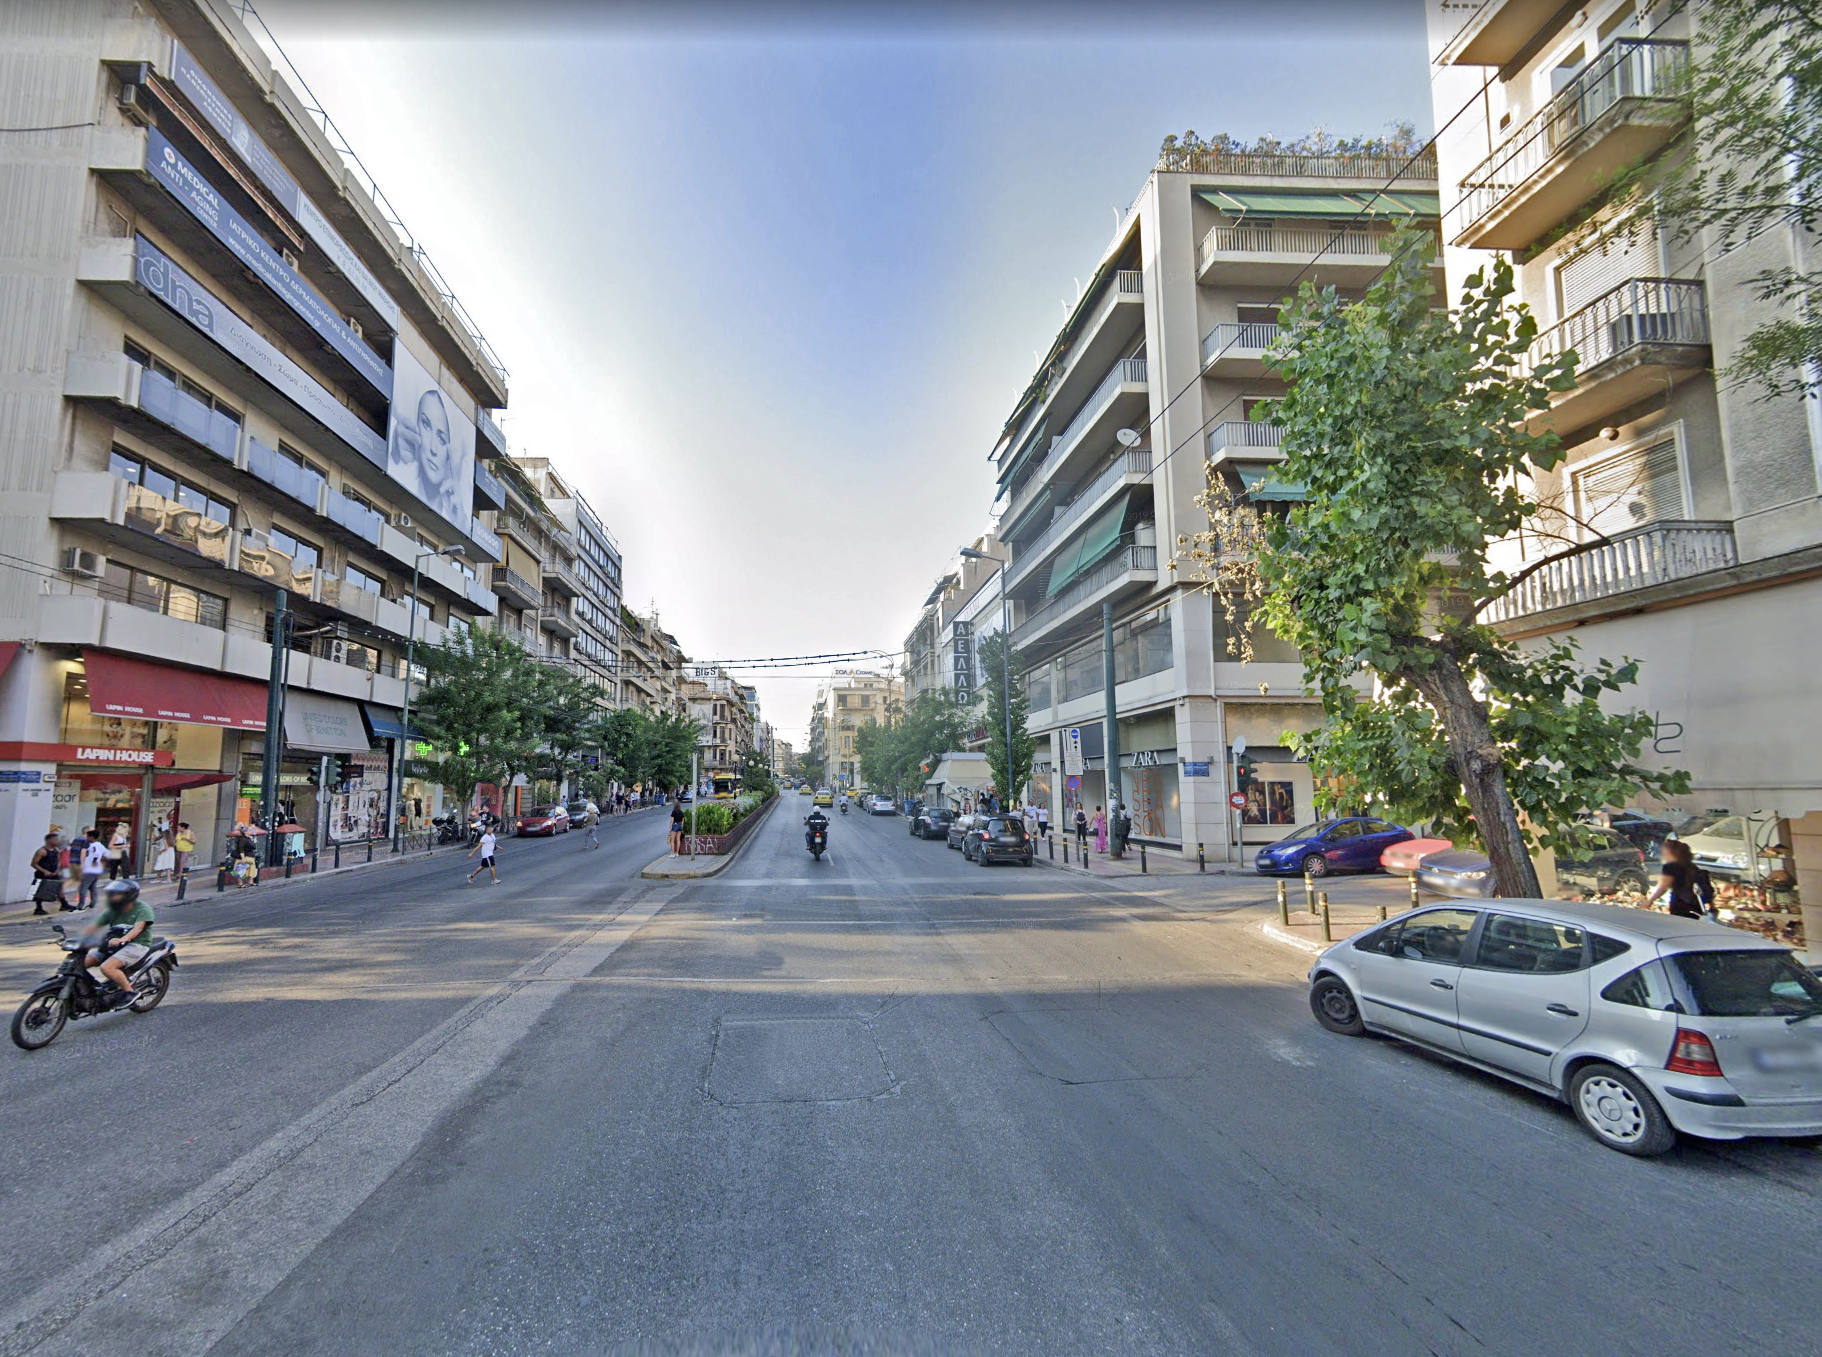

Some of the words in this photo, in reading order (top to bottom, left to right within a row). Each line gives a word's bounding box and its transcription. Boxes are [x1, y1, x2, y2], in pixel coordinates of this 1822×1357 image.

[160, 160, 182, 186] ANTI
[191, 191, 218, 221] AGING
[177, 161, 219, 210] MEDICAL
[196, 206, 218, 228] CENTER
[140, 257, 217, 336] dna
[229, 219, 260, 253] ΙΑΤΡΙΚΟ
[260, 249, 290, 283] ΚΕΝΤΡΟ
[290, 276, 341, 335] ΔΕΡΜΑΤΟΛΟΓΙΑΣ
[956, 623, 968, 703] ΑΕΛΛΩ
[76, 747, 114, 761] LAPIN
[116, 750, 154, 763] HOUSE
[1132, 750, 1160, 767] ZARA
[1133, 813, 1166, 839] SON
